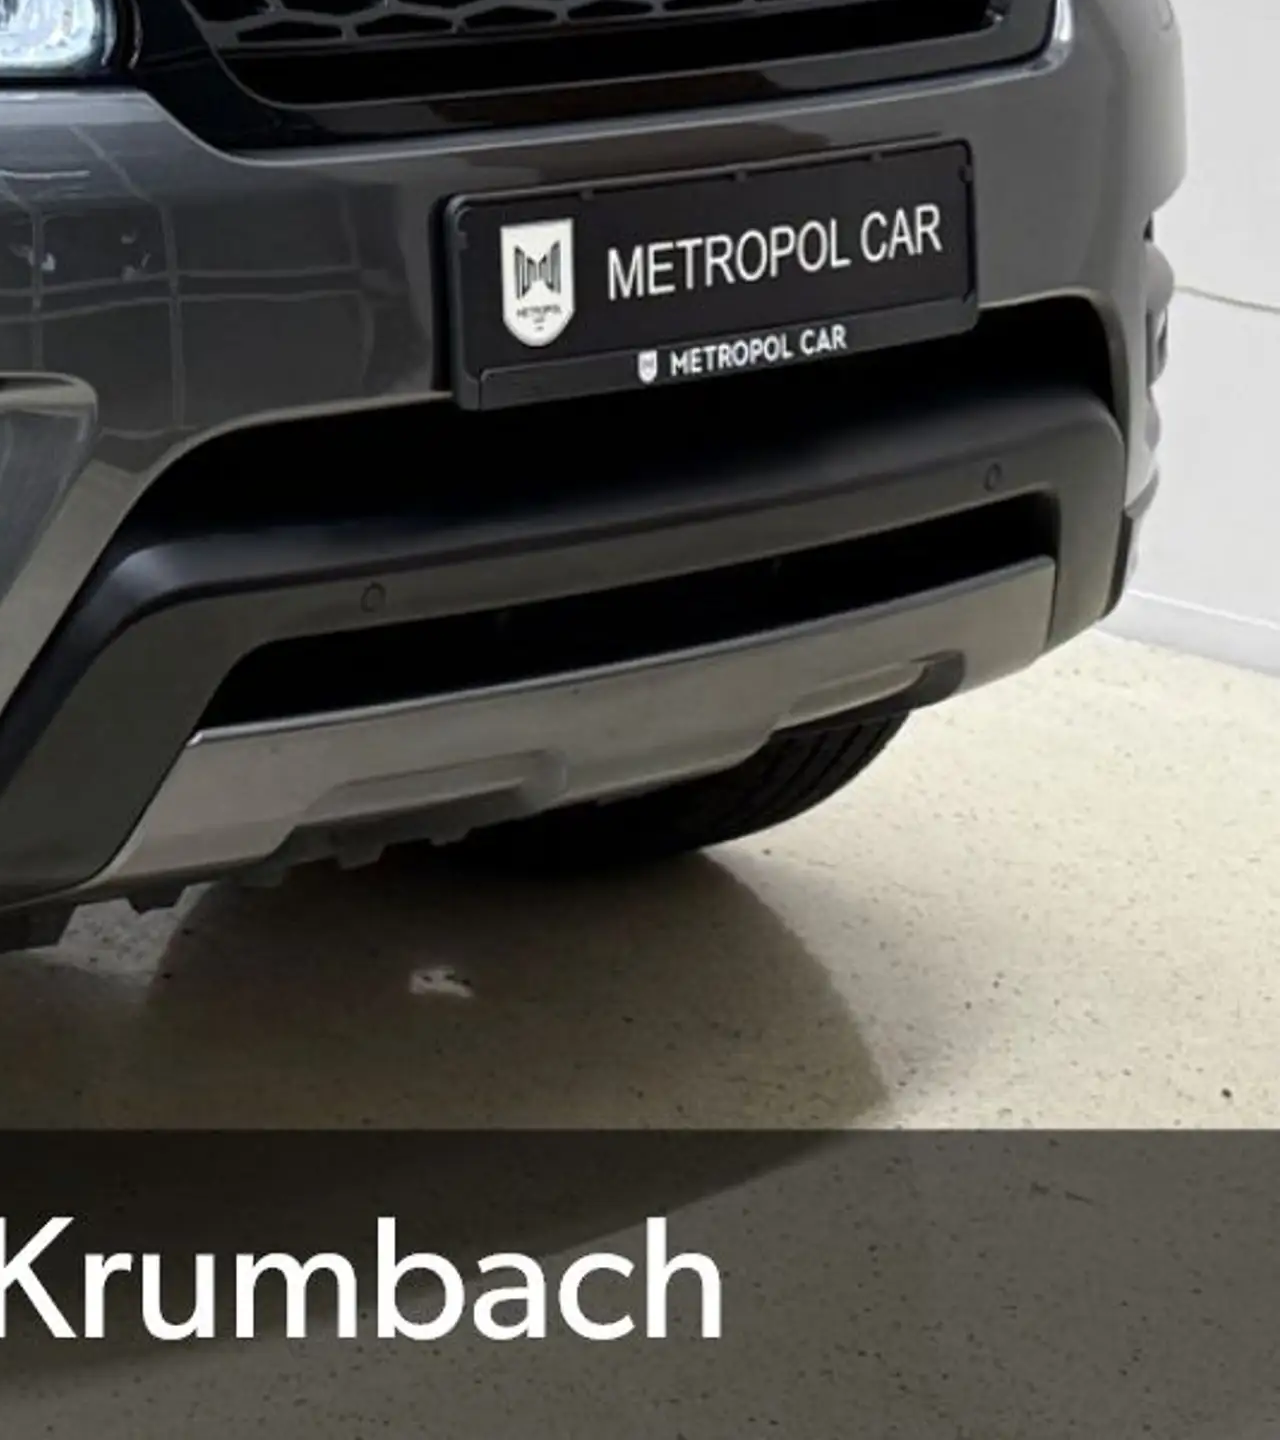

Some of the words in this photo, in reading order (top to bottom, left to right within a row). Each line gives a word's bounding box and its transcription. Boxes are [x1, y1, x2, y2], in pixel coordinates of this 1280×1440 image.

[607, 217, 850, 301] METROPOL
[860, 203, 943, 262] CAR
[670, 333, 794, 376] METROPOL
[799, 324, 848, 356] CAR
